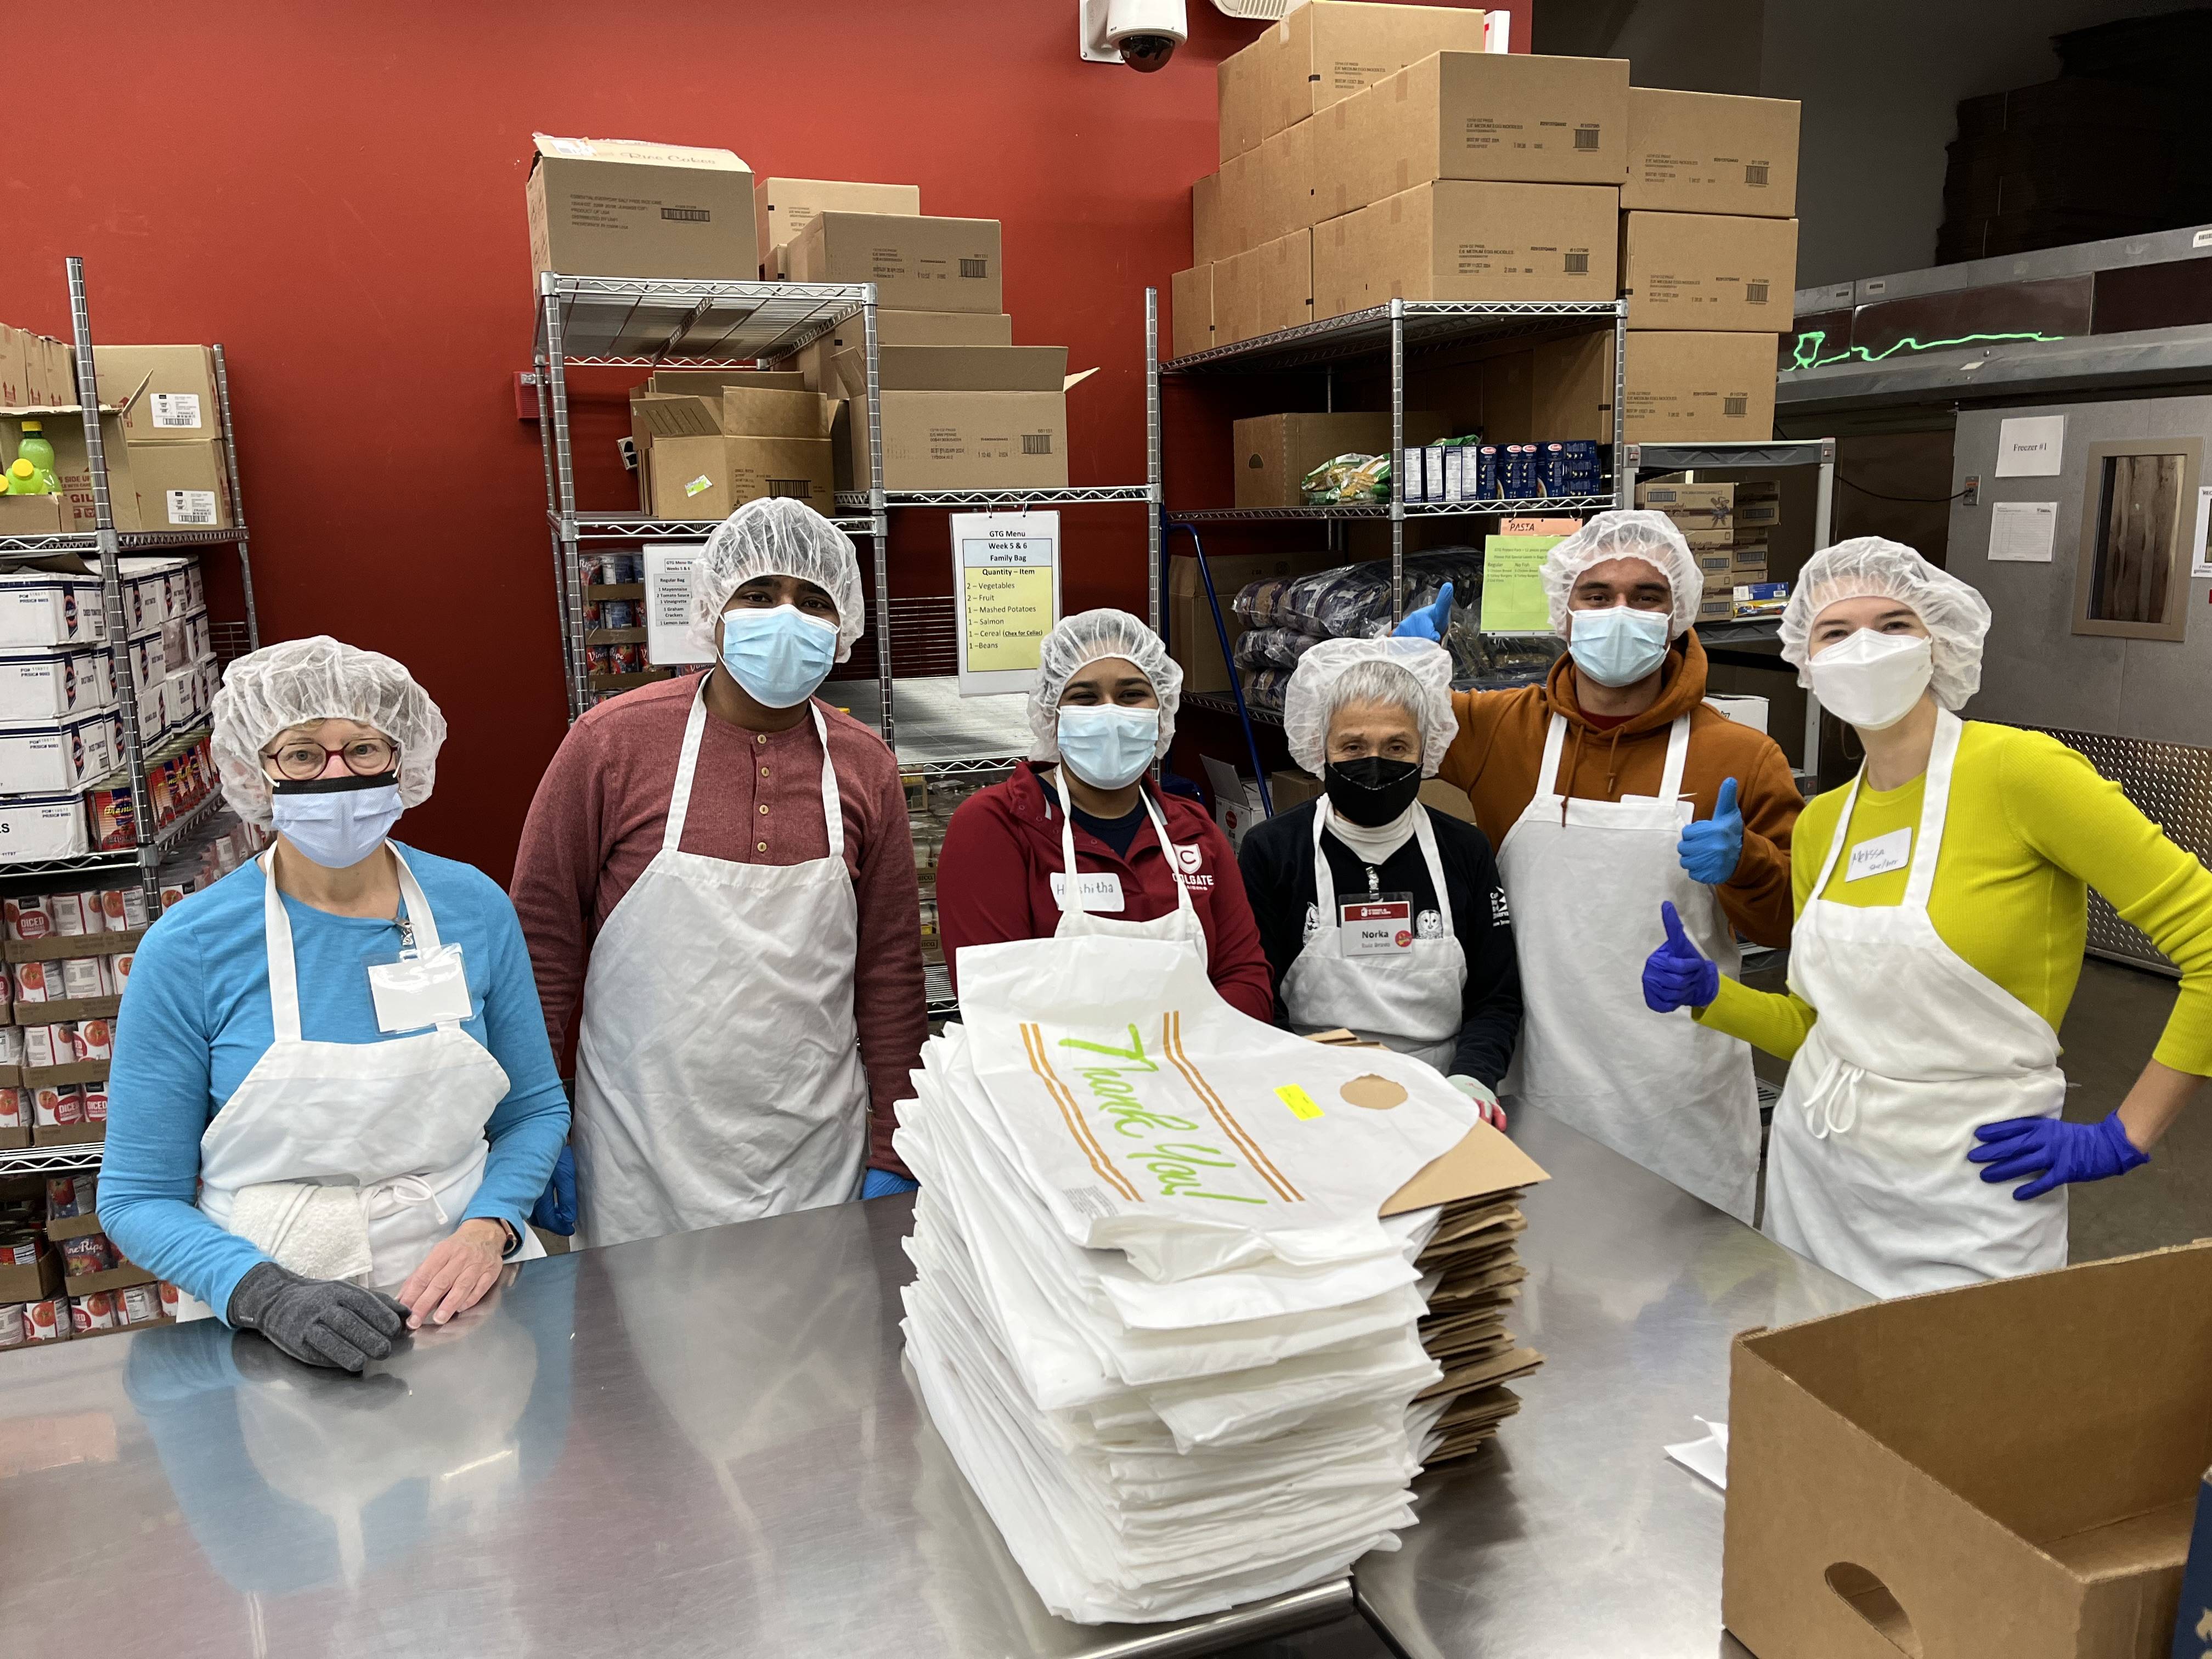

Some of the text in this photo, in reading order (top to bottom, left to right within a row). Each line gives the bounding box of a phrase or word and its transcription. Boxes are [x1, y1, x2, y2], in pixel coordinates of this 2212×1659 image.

[668, 155, 715, 164] Cakes
[979, 582, 1015, 590] Vegetables
[1180, 850, 1196, 864] C
[1852, 849, 1886, 865] Melissa
[1057, 882, 1113, 895] Hshitha
[21, 917, 44, 927] DICED
[1362, 930, 1389, 939] Norka
[1059, 1023, 1199, 1138] Thank
[59, 1101, 80, 1113] DICED
